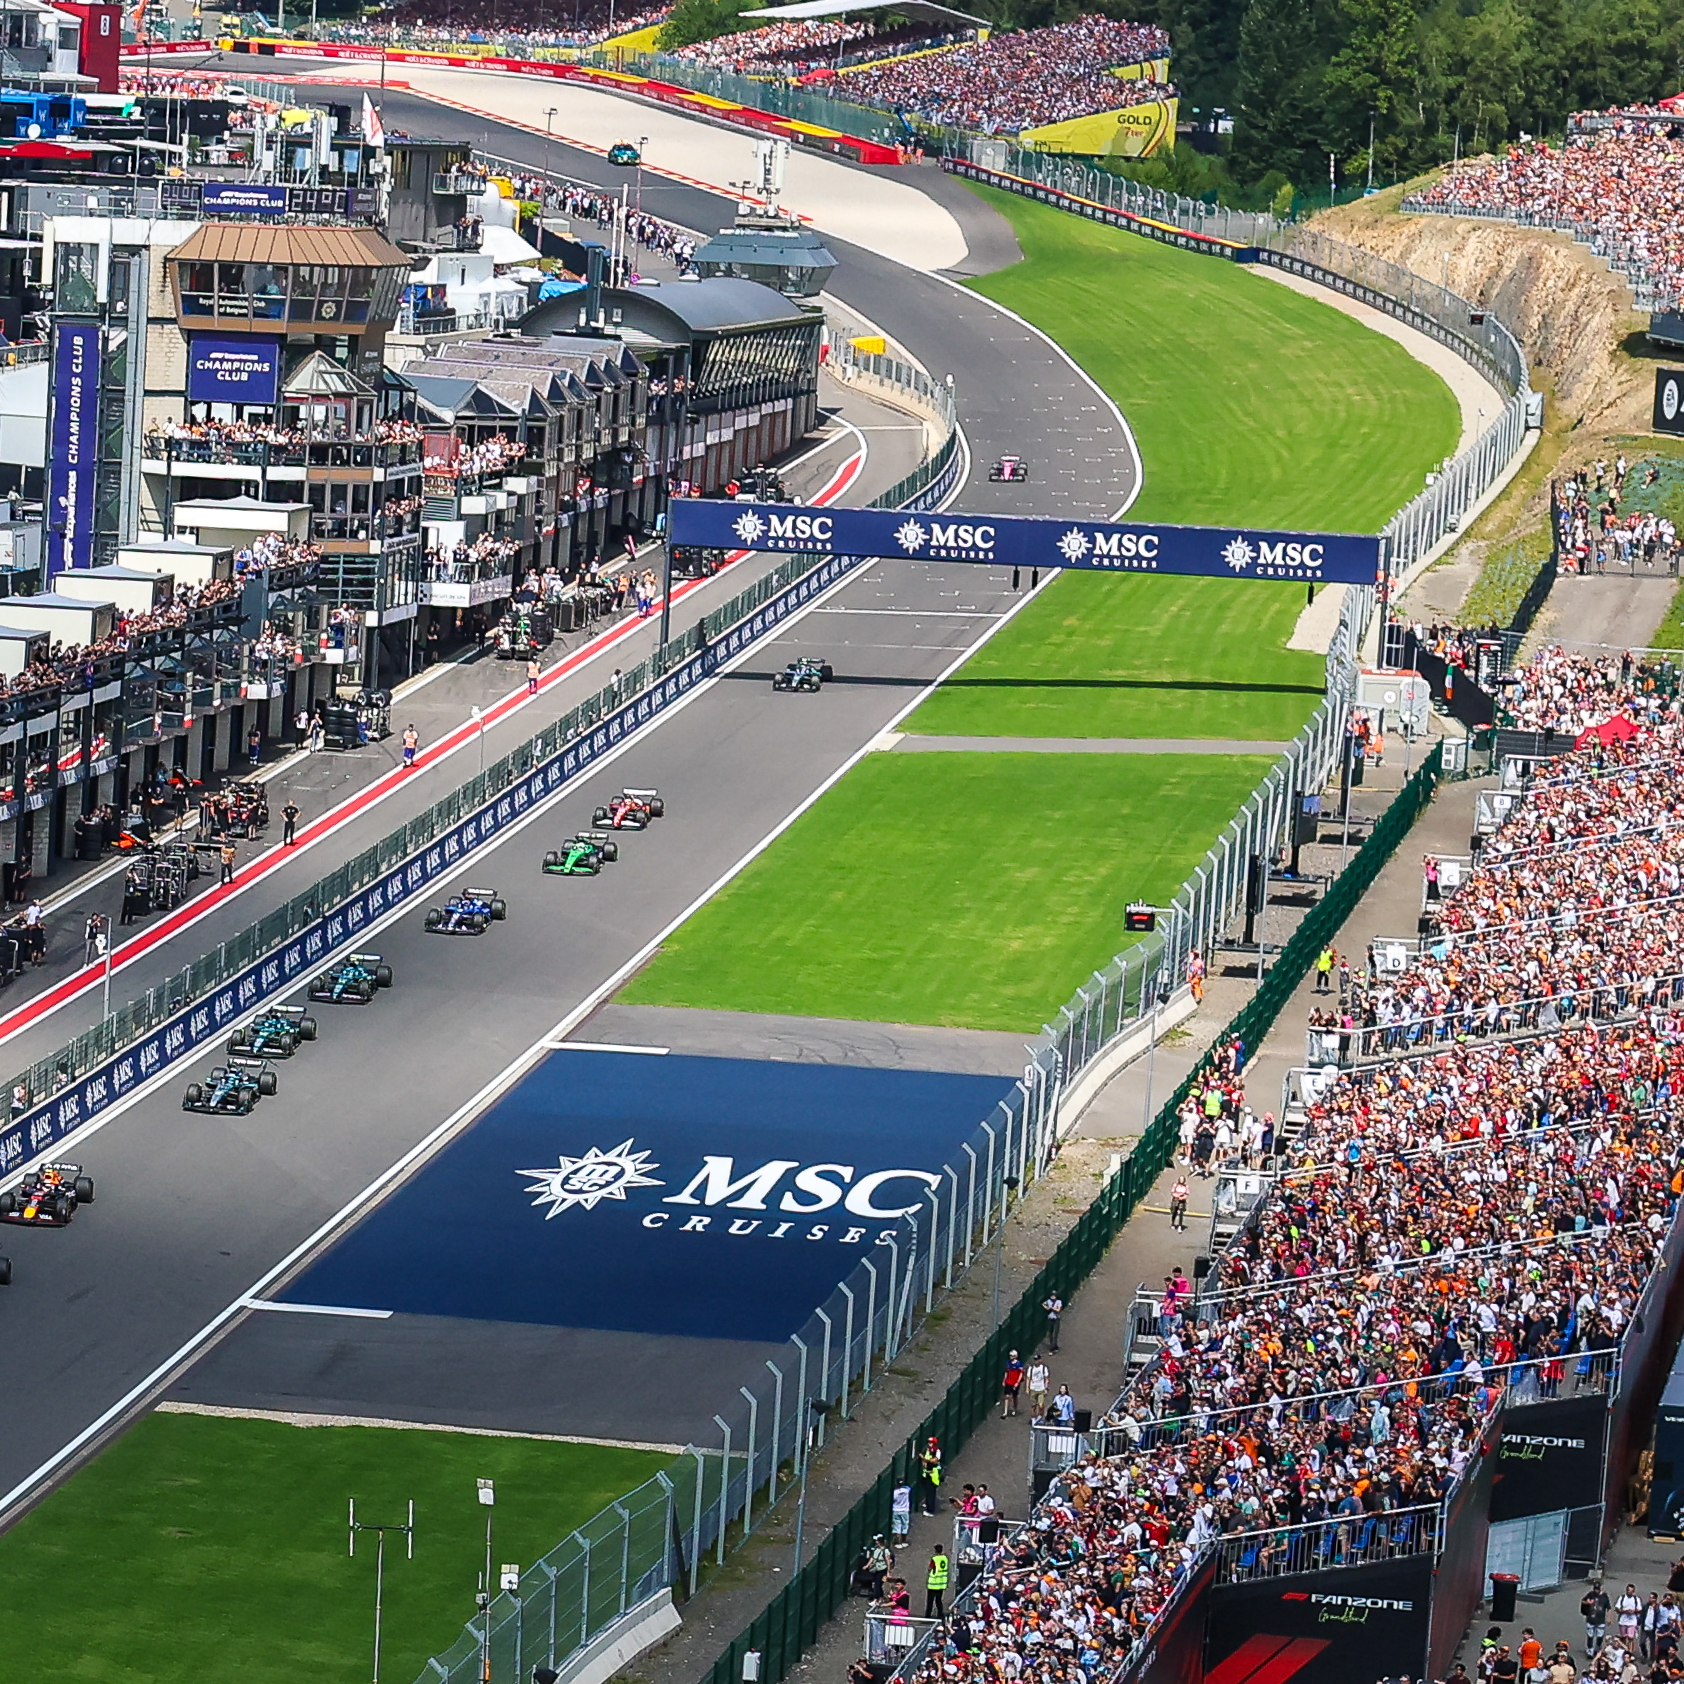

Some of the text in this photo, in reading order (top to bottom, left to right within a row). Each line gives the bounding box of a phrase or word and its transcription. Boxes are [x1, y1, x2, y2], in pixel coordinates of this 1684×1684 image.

[1117, 114, 1152, 125] GOLD
[204, 196, 283, 208] CHAMPIONS CLUB
[72, 336, 84, 374] CLUB
[196, 360, 270, 372] CHAMPIONS
[217, 371, 248, 381] CLUB
[68, 377, 82, 464] CHAMPIONS
[768, 514, 833, 539] MSC
[930, 523, 995, 548] MSC
[768, 539, 832, 550] CRUISES
[1093, 533, 1159, 557] MSC
[930, 549, 994, 559] CRUISES
[1258, 542, 1324, 566] MSC
[1092, 558, 1157, 568] CRUISES
[1257, 567, 1322, 577] CRUISES
[1392, 959, 1400, 968] D
[662, 1155, 942, 1218] MSC
[642, 1213, 898, 1245] CRUISES
[1501, 1434, 1585, 1449] ANZONE
[1311, 1594, 1413, 1611] FANZONE
